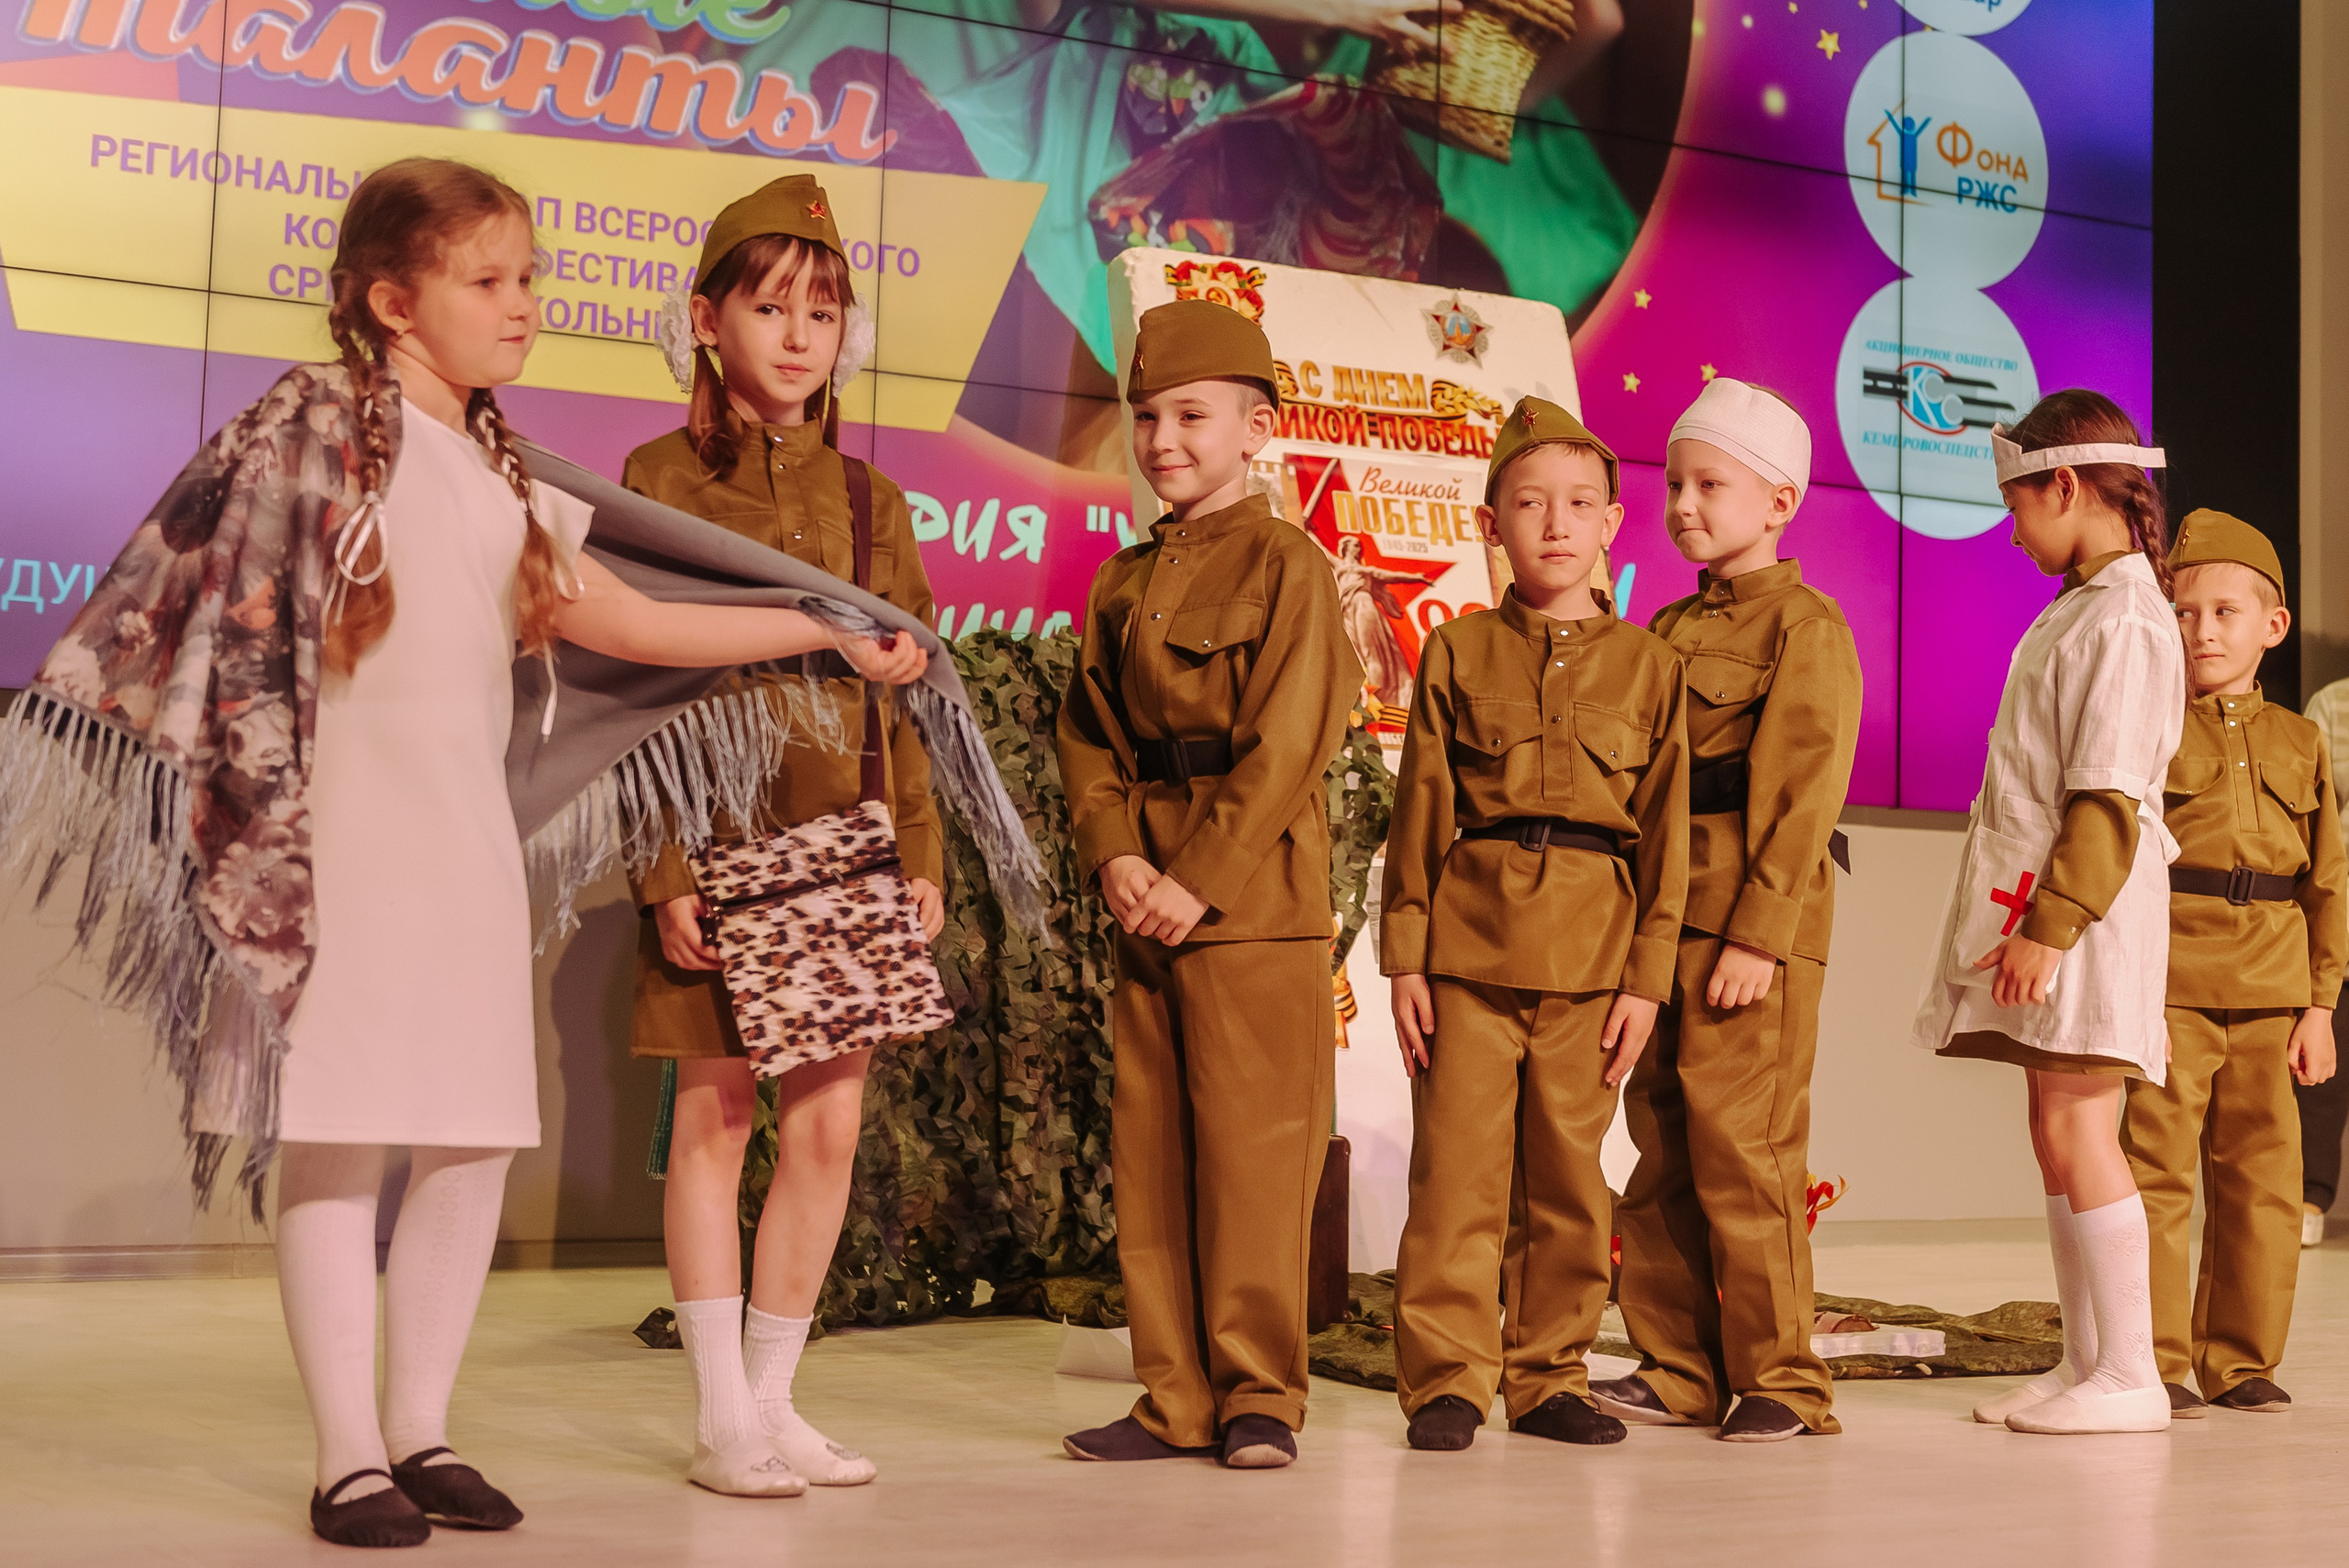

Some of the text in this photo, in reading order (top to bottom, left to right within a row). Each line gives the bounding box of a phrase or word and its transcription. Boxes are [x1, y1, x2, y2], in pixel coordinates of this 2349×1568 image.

[90, 133, 362, 200] РЕГИОНАЛЬ
[1957, 176, 2018, 214] РЖС
[1299, 361, 1429, 410] С ДНЕМ
[1272, 402, 1369, 448] ИКОЙ
[1863, 430, 1994, 461] КЕМЕРОВОСПЕЦСТ
[1359, 466, 1463, 501] Великой
